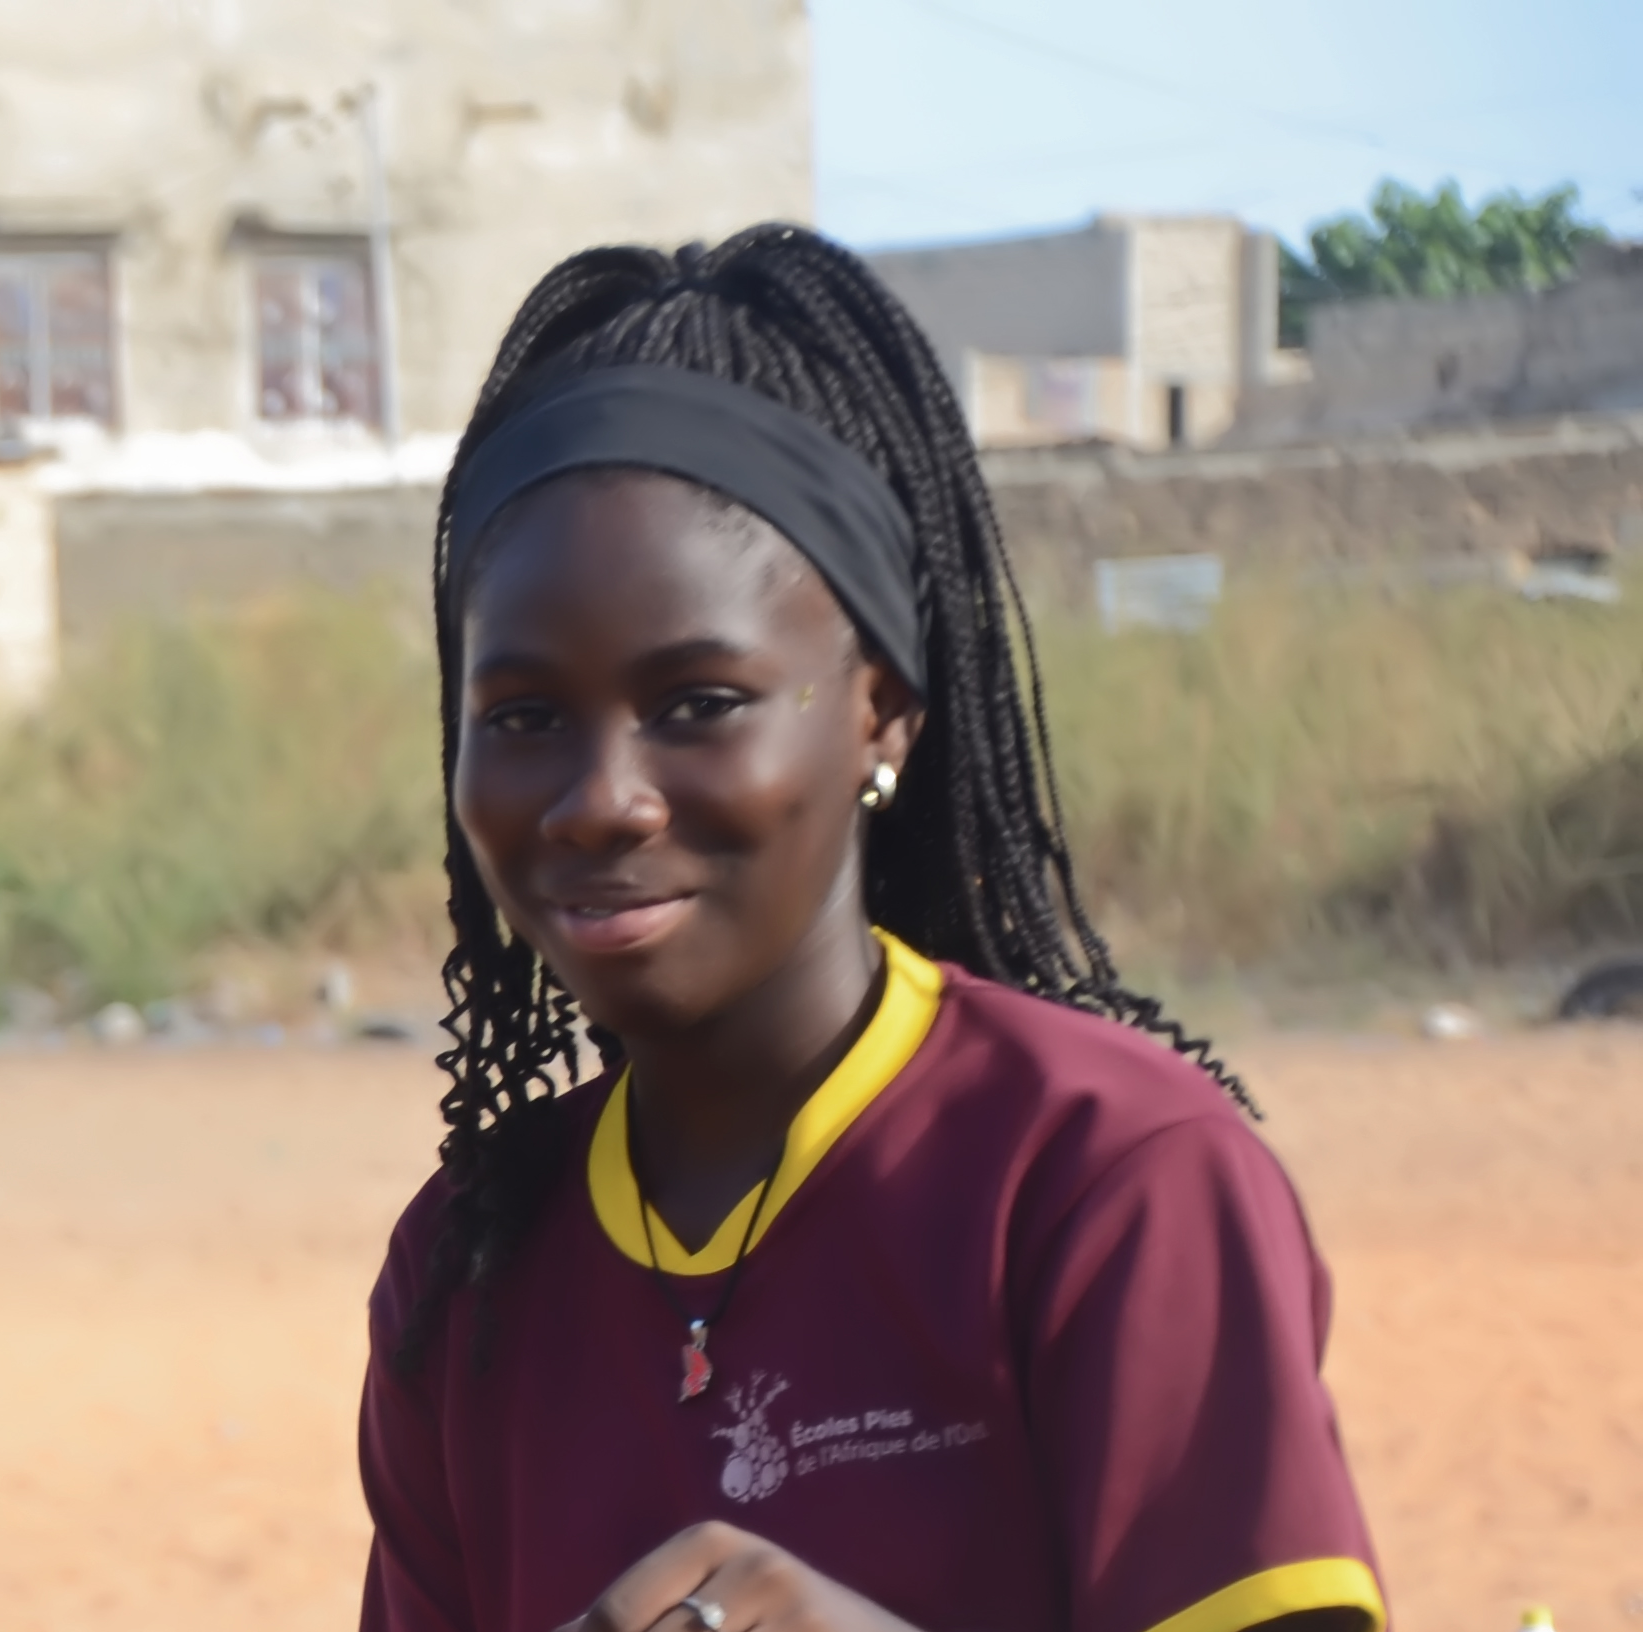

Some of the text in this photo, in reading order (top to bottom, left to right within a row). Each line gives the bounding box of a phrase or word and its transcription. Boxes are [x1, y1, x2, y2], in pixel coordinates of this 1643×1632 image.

[790, 1409, 913, 1448] Écoles Pies
[795, 1453, 817, 1476] de
[911, 1430, 940, 1453] de
